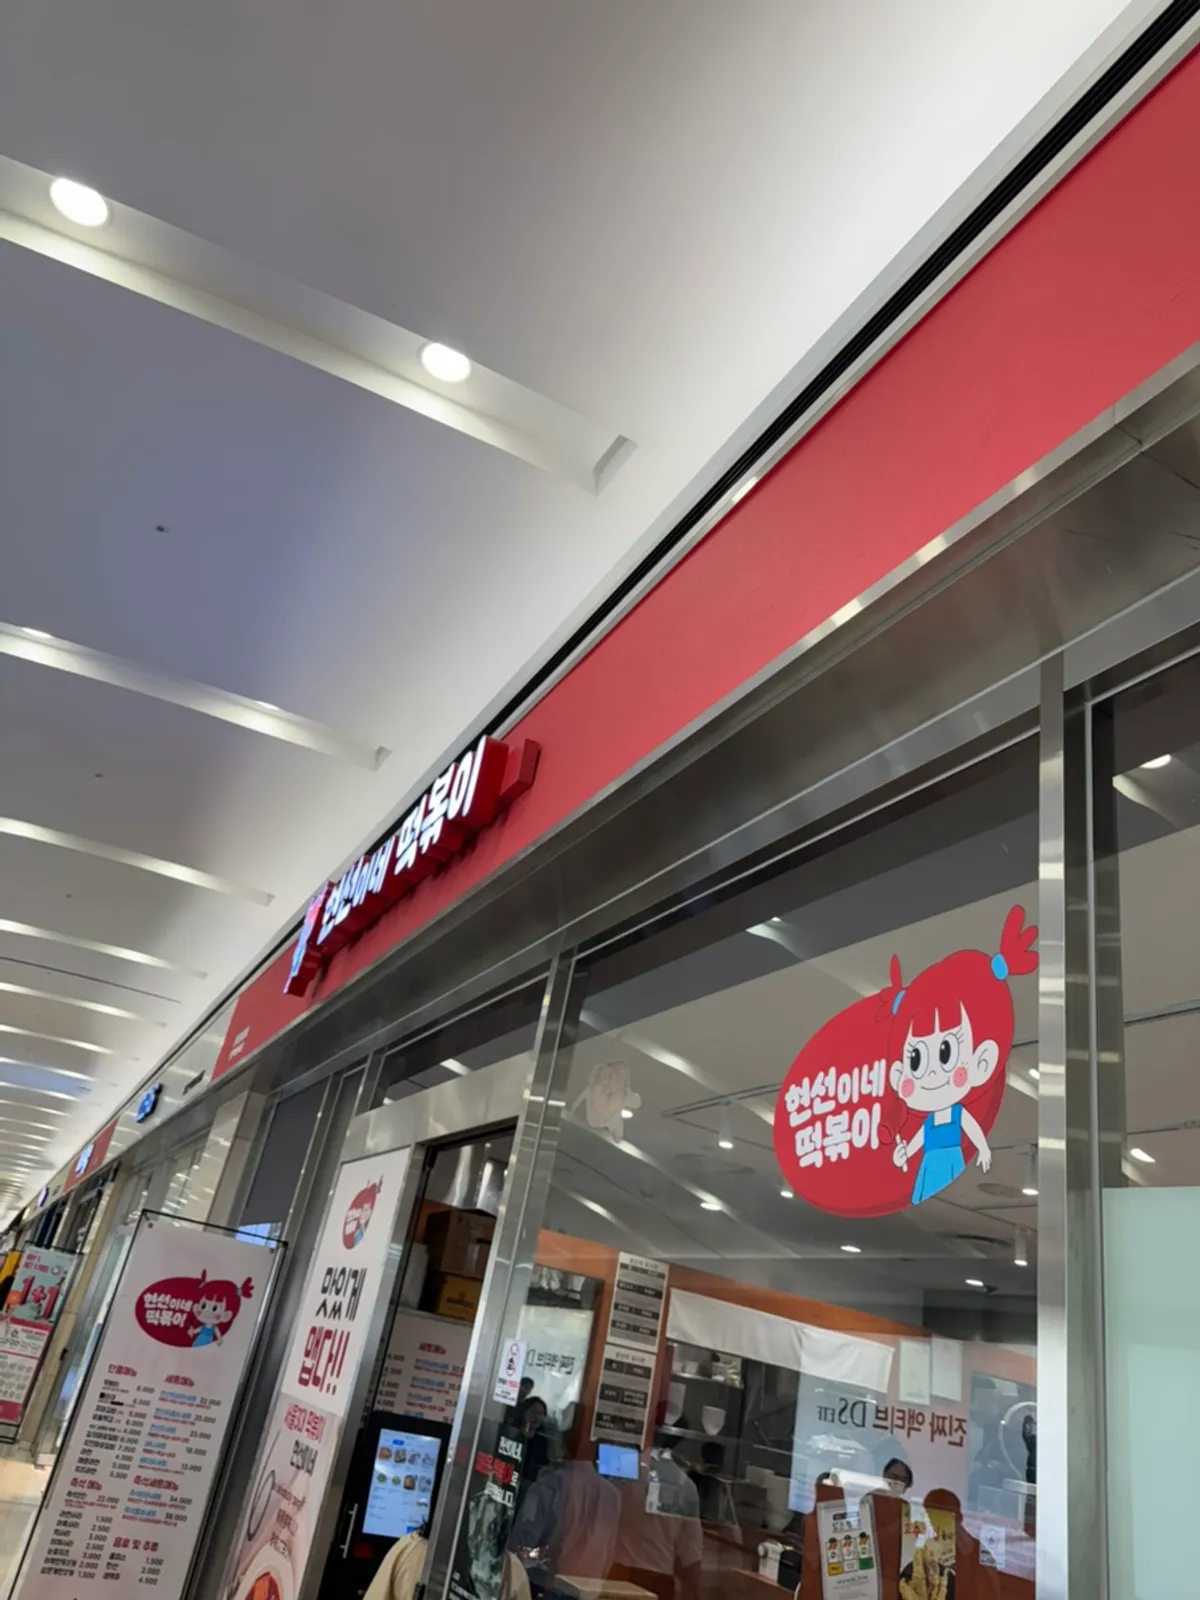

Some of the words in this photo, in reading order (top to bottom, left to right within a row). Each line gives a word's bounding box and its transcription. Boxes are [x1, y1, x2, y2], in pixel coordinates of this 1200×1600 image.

[316, 835, 397, 945] 현선이네
[394, 734, 488, 876] 떡볶이
[785, 1058, 887, 1127] 현선이네
[794, 1102, 882, 1168] 떡볶이
[20, 1275, 60, 1320] 1+1
[143, 1292, 193, 1312] 현선이네
[145, 1309, 187, 1328] 떡볶이
[315, 1267, 367, 1321] 맛있게
[298, 1326, 351, 1396] 맵다!!
[132, 1539, 141, 1550] 및
